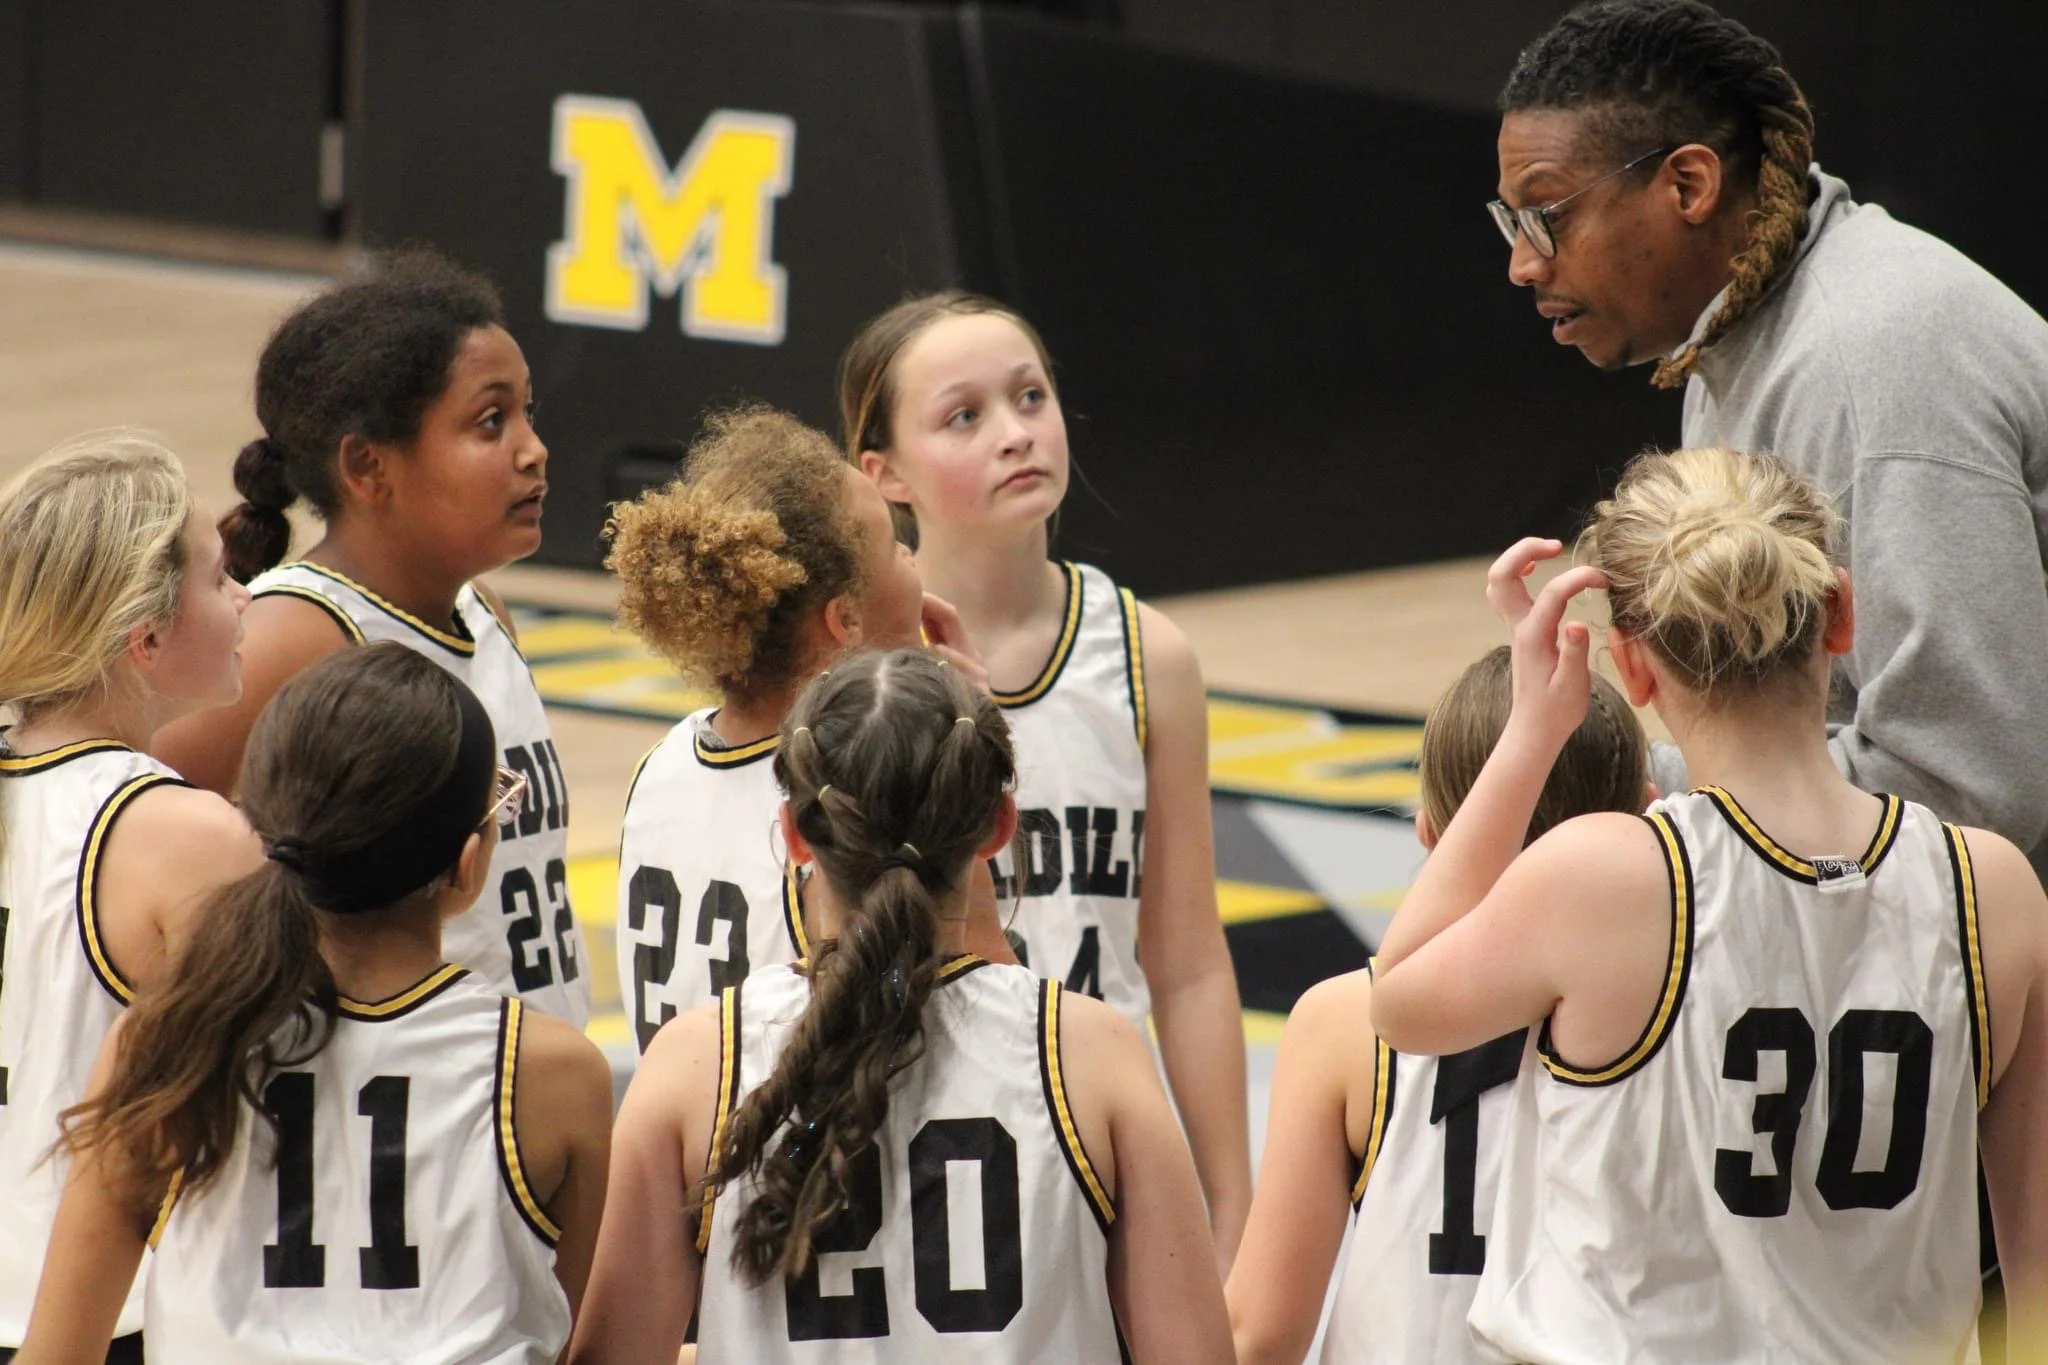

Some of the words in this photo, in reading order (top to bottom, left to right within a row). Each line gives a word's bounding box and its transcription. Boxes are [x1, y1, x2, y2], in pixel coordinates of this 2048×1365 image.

[545, 93, 796, 346] M
[500, 857, 579, 992] 22
[629, 864, 750, 1056] 23
[263, 1072, 420, 1290] 11
[1714, 1007, 1934, 1218] 30
[785, 1117, 1023, 1342] 20
